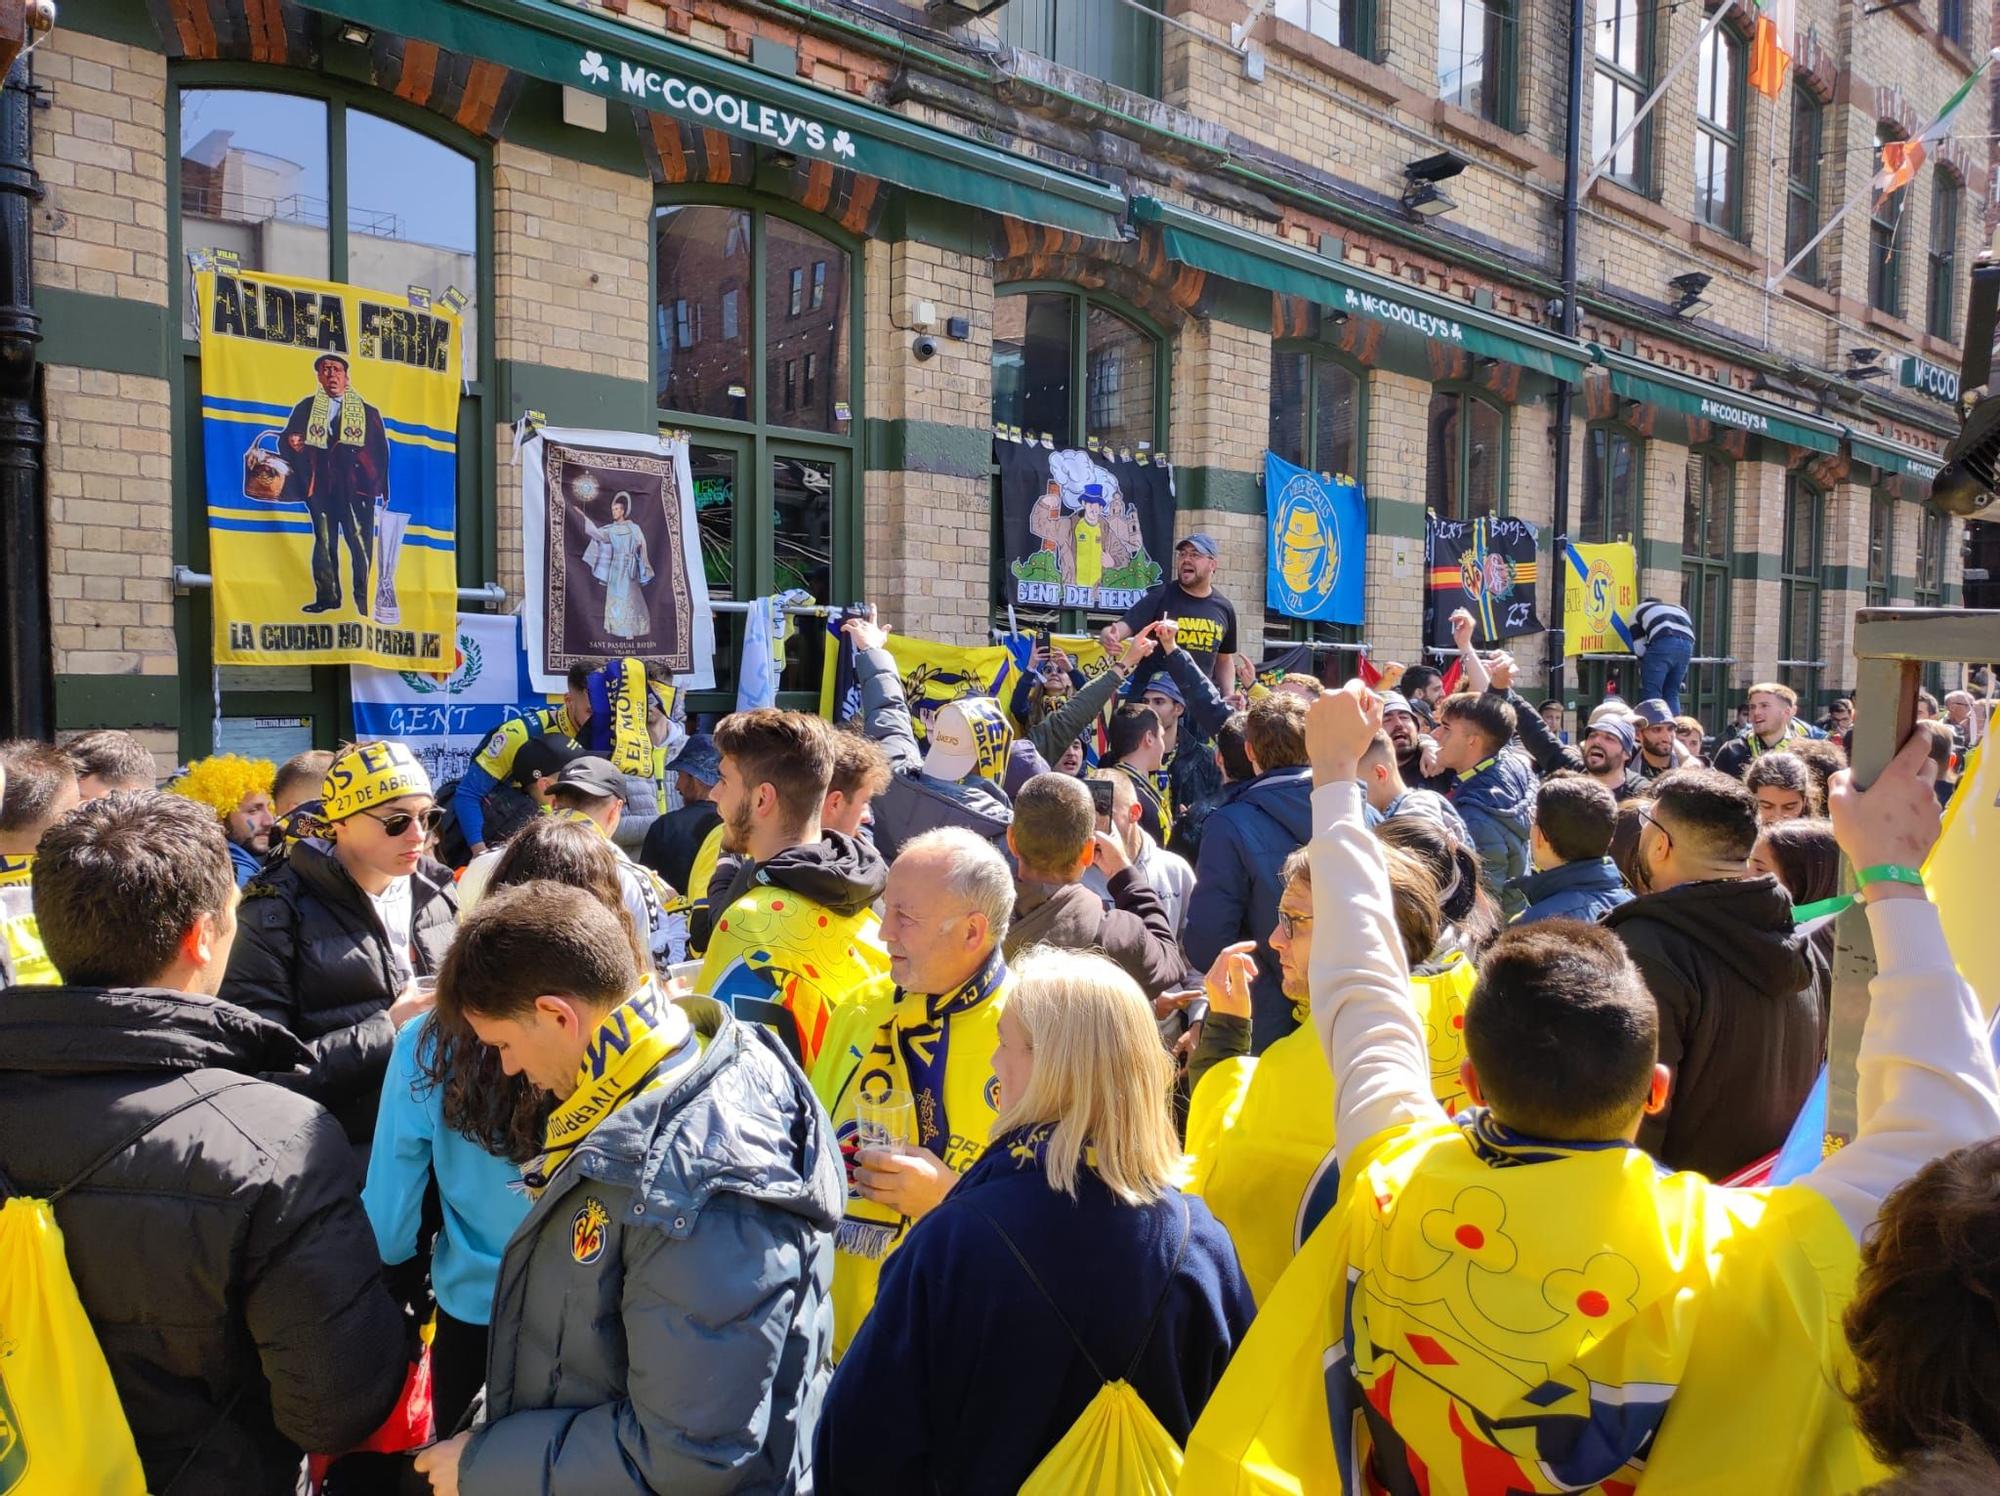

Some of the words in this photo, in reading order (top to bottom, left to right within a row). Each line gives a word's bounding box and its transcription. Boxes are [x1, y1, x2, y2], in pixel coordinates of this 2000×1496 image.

[213, 273, 348, 353] ALDEA
[1018, 582, 1061, 605] GENT
[1064, 585, 1095, 608] DEL
[1176, 629, 1215, 647] DAYS
[1177, 616, 1216, 633] AWAY
[231, 624, 255, 650] LA
[261, 624, 334, 651] CIUDAD
[337, 623, 362, 649] NO
[375, 627, 417, 657] PARA
[389, 706, 476, 735] GENT
[335, 795, 353, 811] 27
[355, 786, 374, 804] DE
[379, 774, 421, 795] ABRIL
